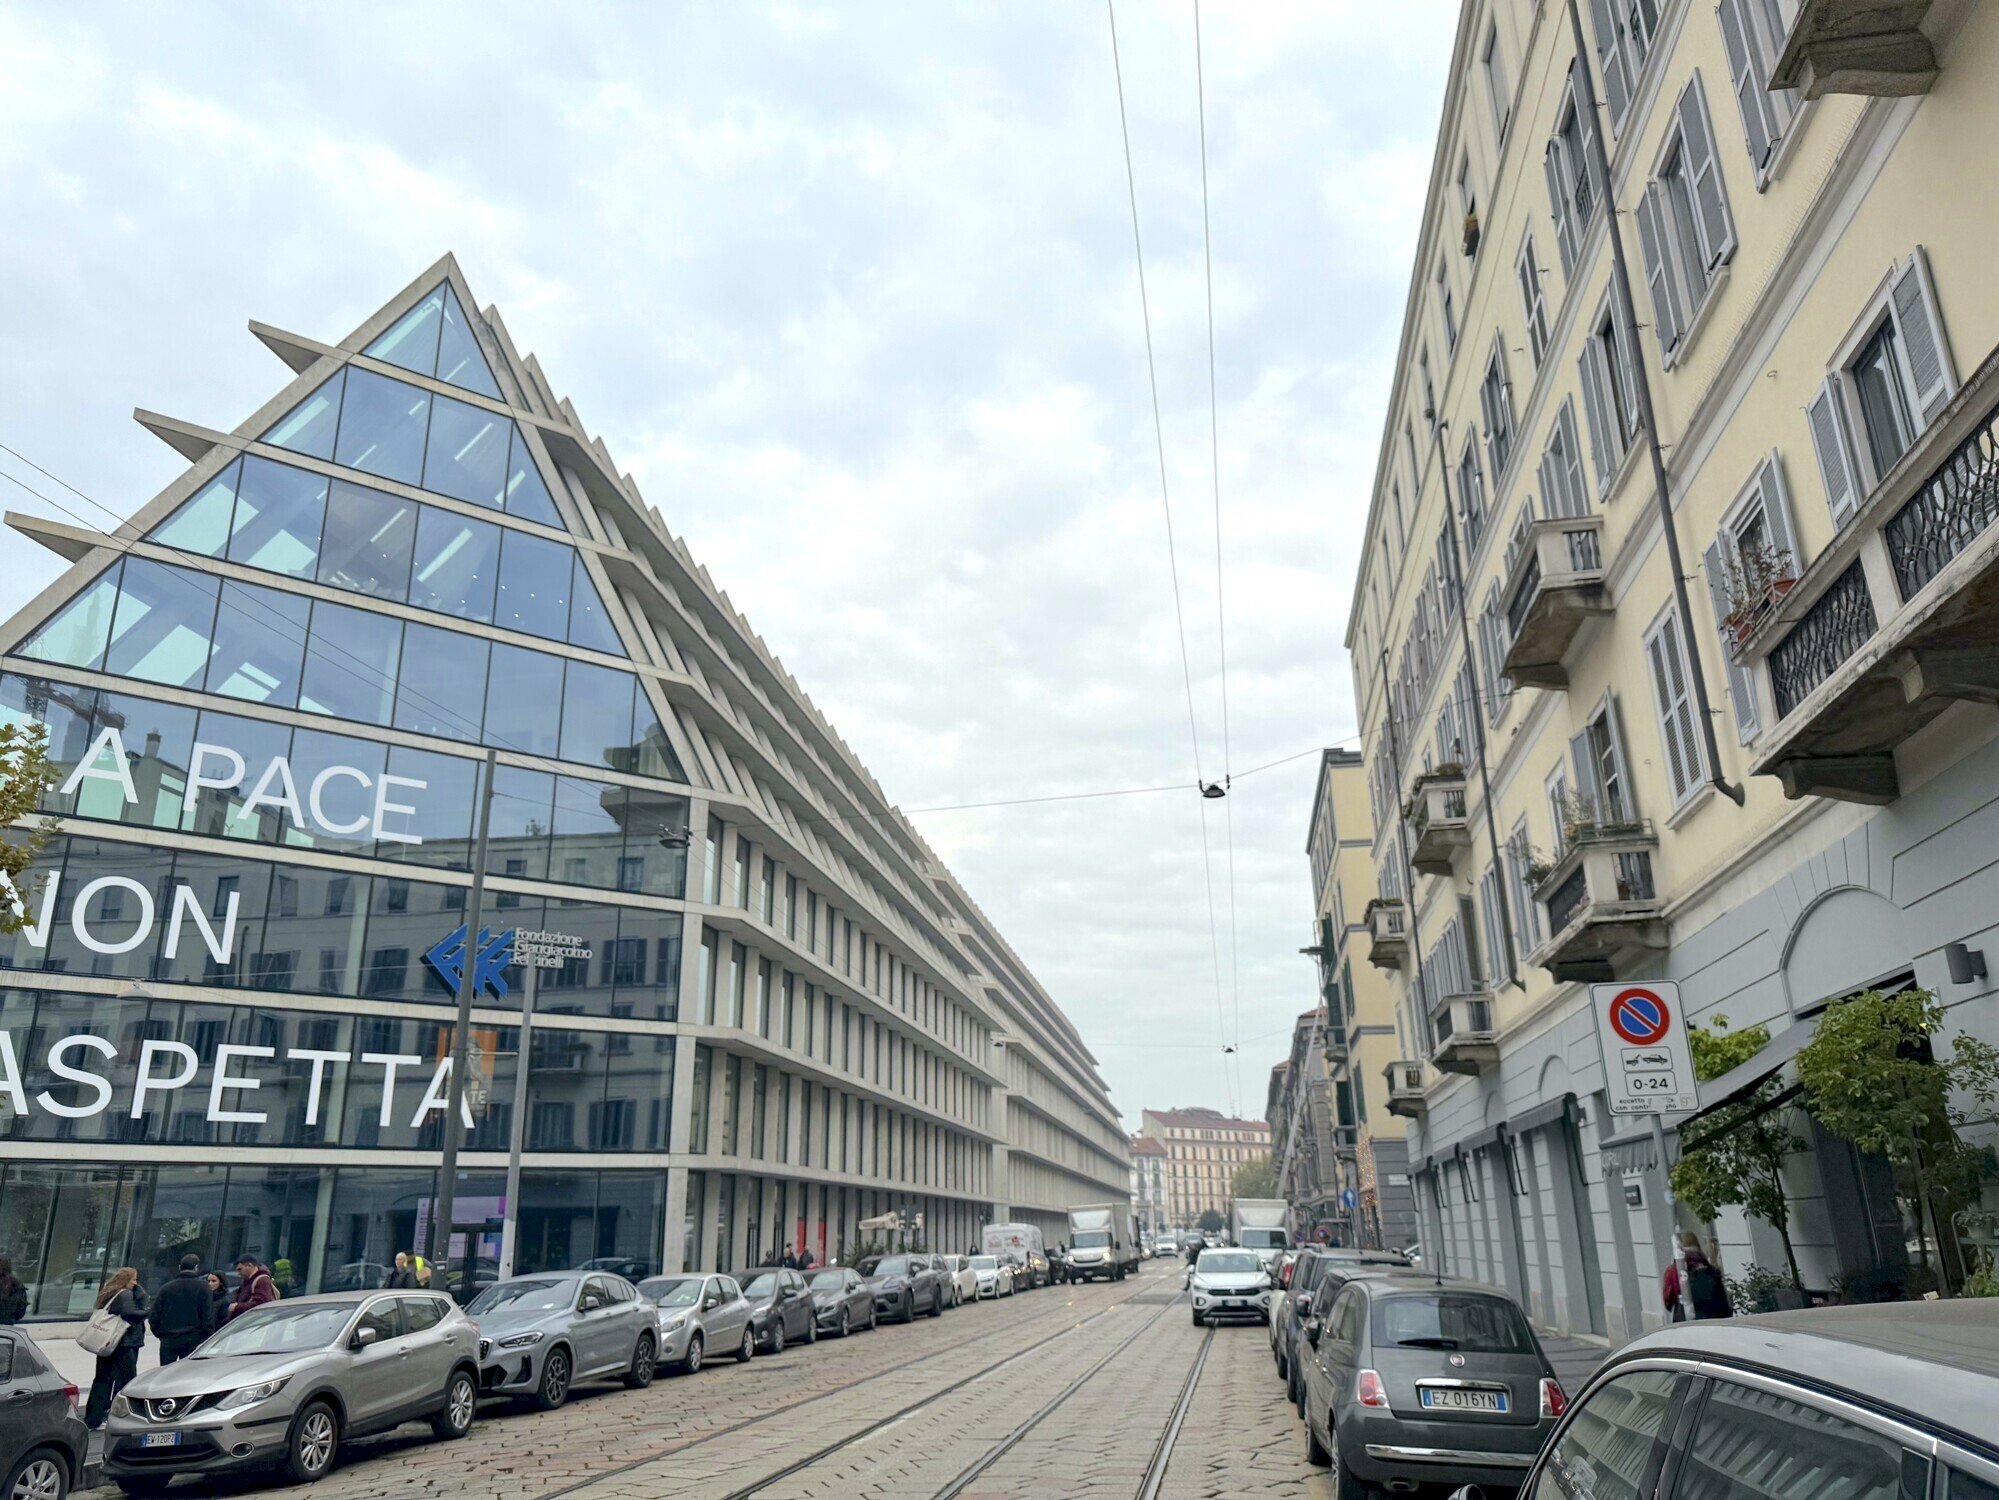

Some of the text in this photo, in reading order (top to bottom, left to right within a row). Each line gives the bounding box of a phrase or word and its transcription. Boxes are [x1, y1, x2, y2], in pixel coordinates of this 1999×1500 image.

[183, 741, 428, 845] PACE
[0, 869, 240, 965] NON
[516, 927, 583, 946] Fondazione
[515, 940, 593, 959] Giangiacomo
[0, 1030, 475, 1129] ASPETTA
[1633, 1078, 1669, 1090] 0-24
[1432, 1391, 1497, 1408] EZ 016YN
